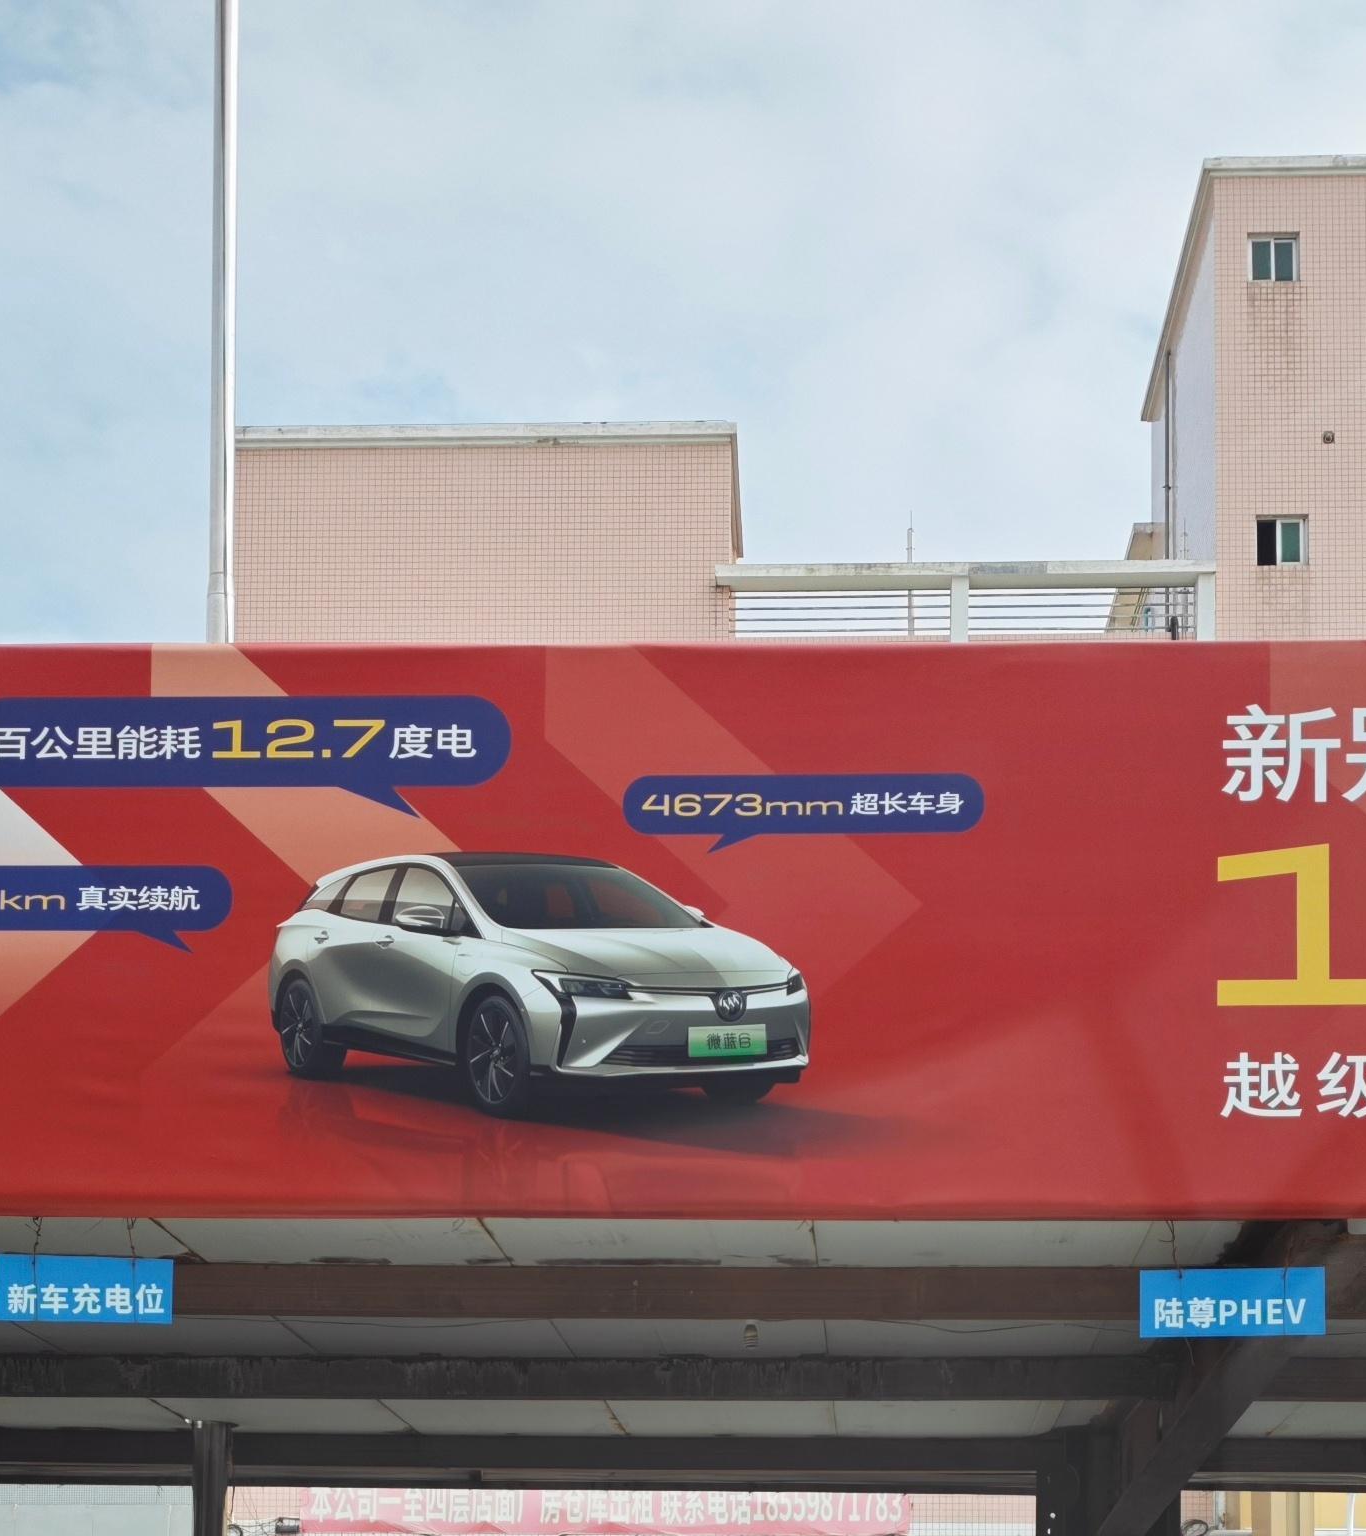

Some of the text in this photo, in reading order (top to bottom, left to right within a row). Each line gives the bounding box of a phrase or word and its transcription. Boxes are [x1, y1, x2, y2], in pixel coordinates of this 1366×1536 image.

[7, 1283, 165, 1315] 新车充电位
[1154, 1297, 1306, 1329] 陆尊PHEV
